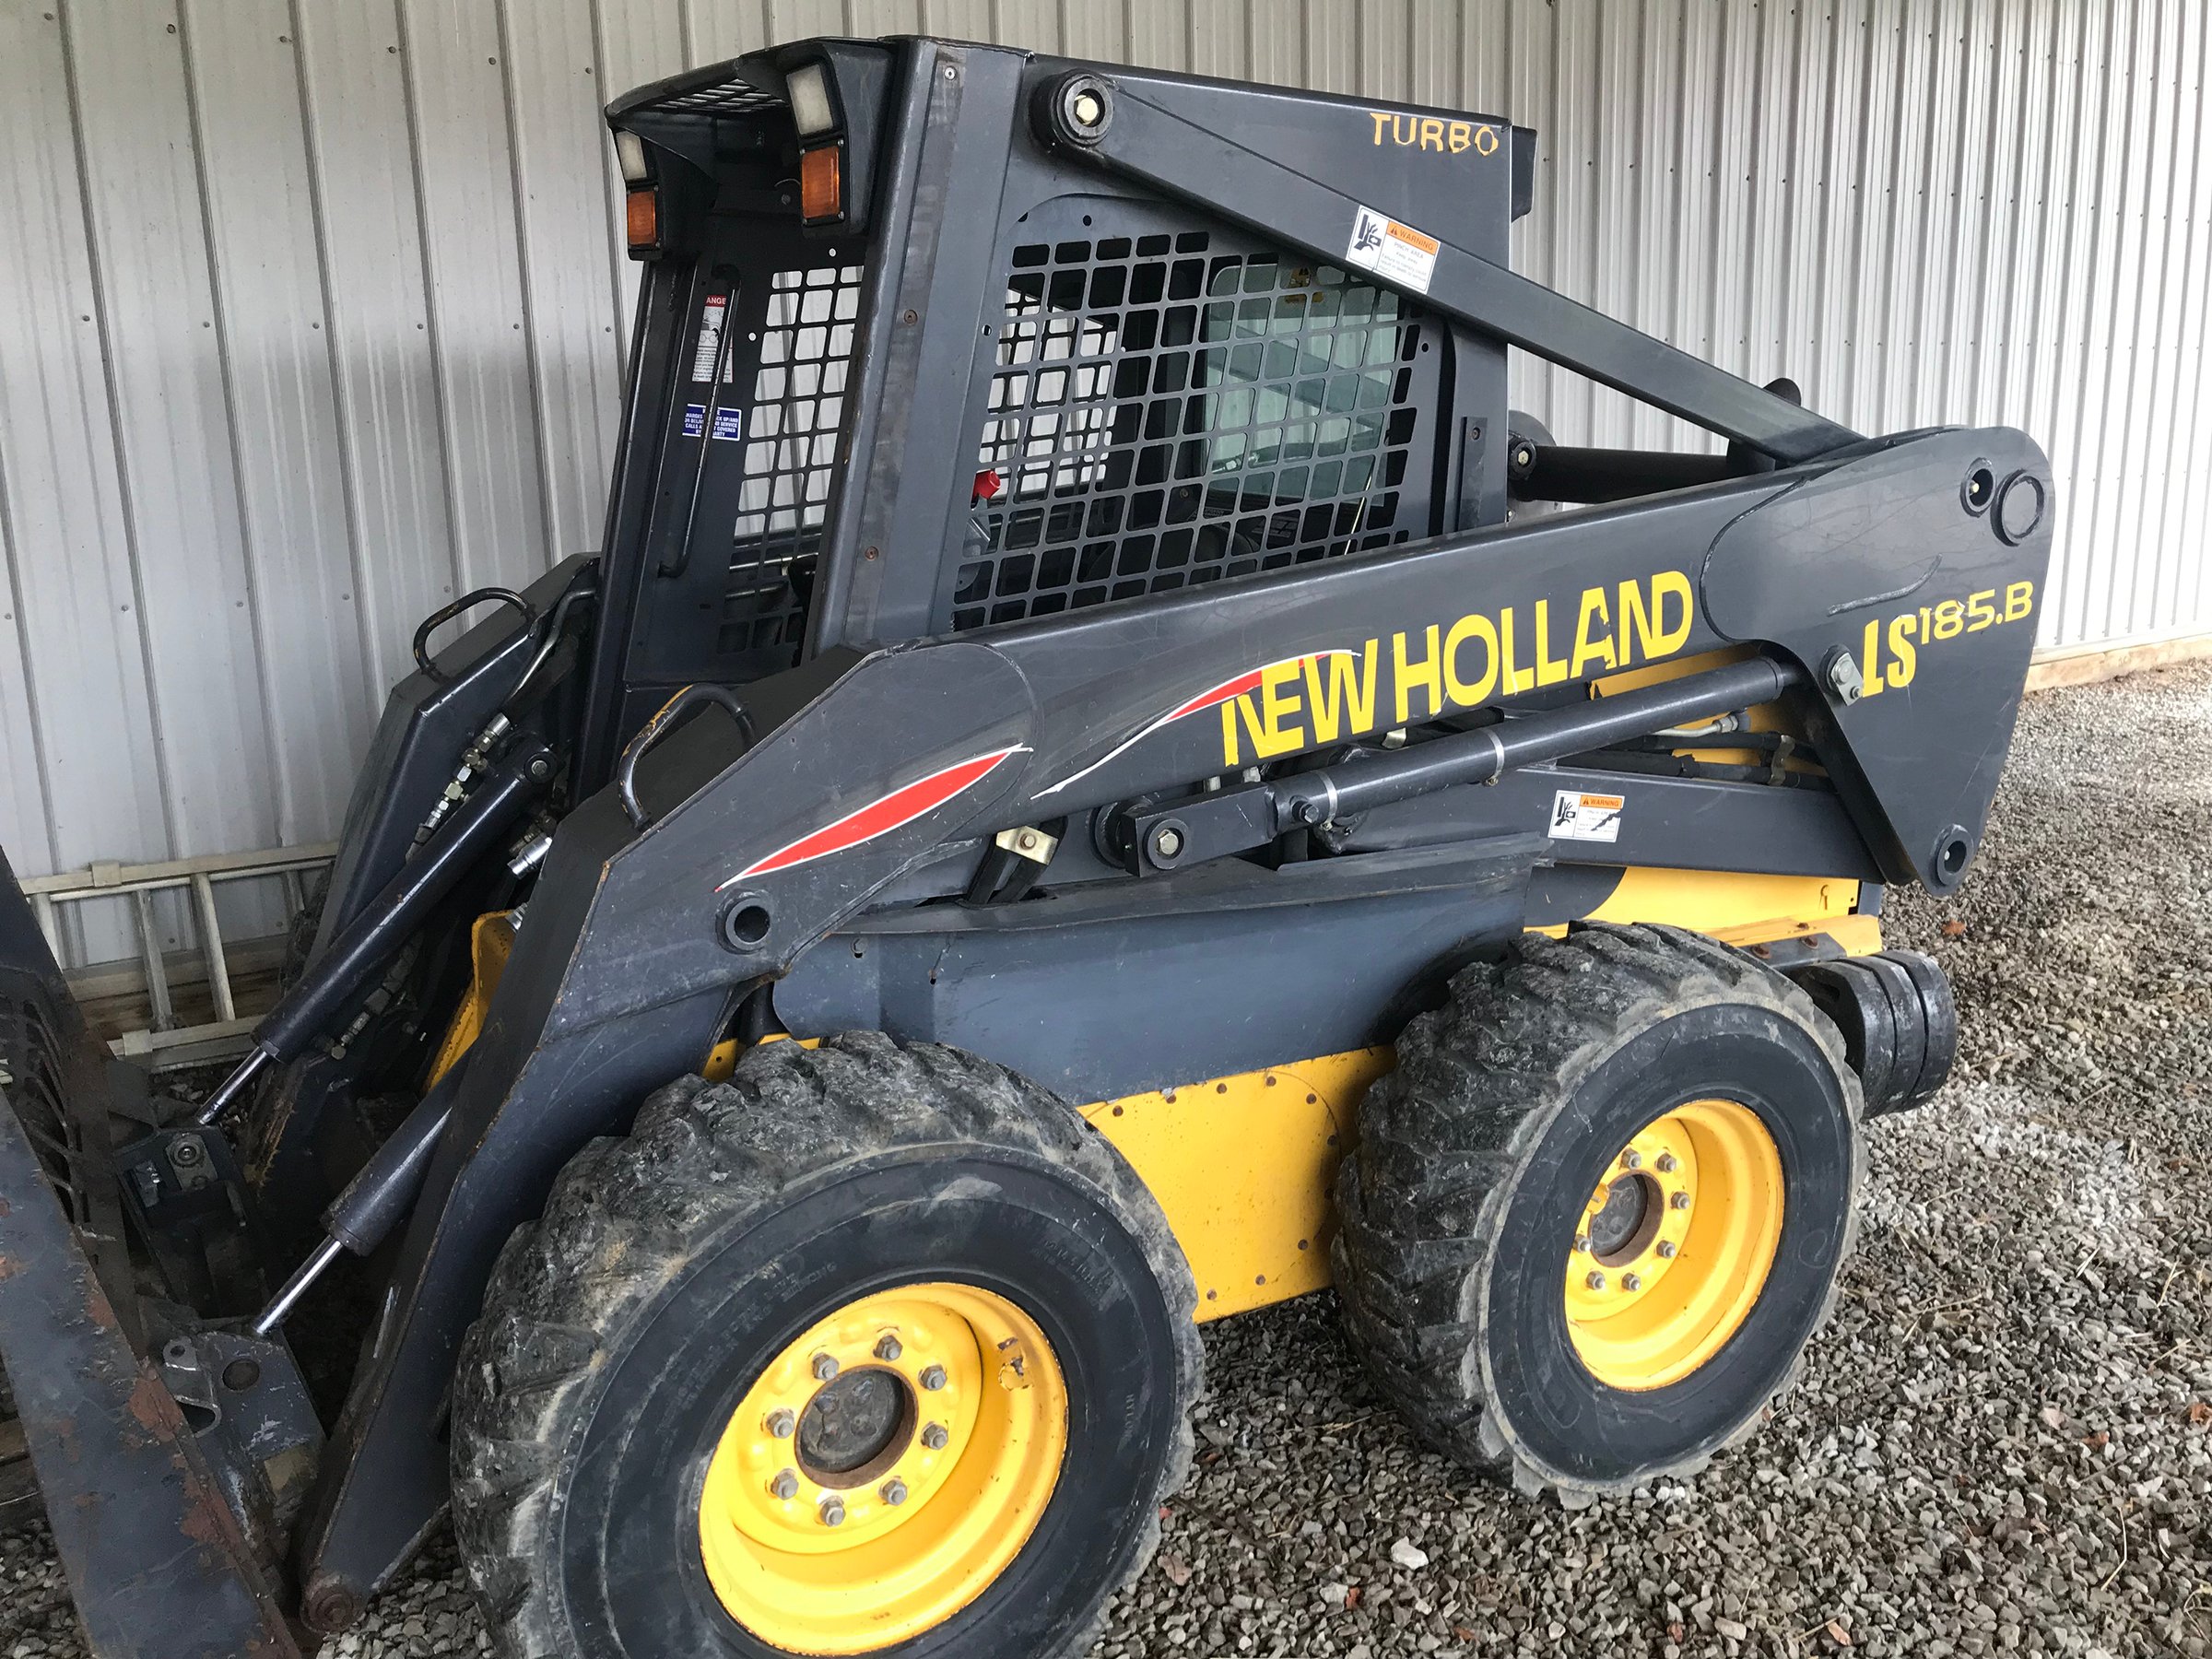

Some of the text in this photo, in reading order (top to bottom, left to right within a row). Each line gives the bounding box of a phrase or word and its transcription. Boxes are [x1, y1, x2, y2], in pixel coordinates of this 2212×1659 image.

[1370, 112, 1499, 156] TURBO
[1400, 229, 1434, 251] WARNING
[706, 297, 726, 305] ANGE
[1221, 571, 1694, 767] NEW HOLLAND
[1590, 797, 1619, 807] WARNING
